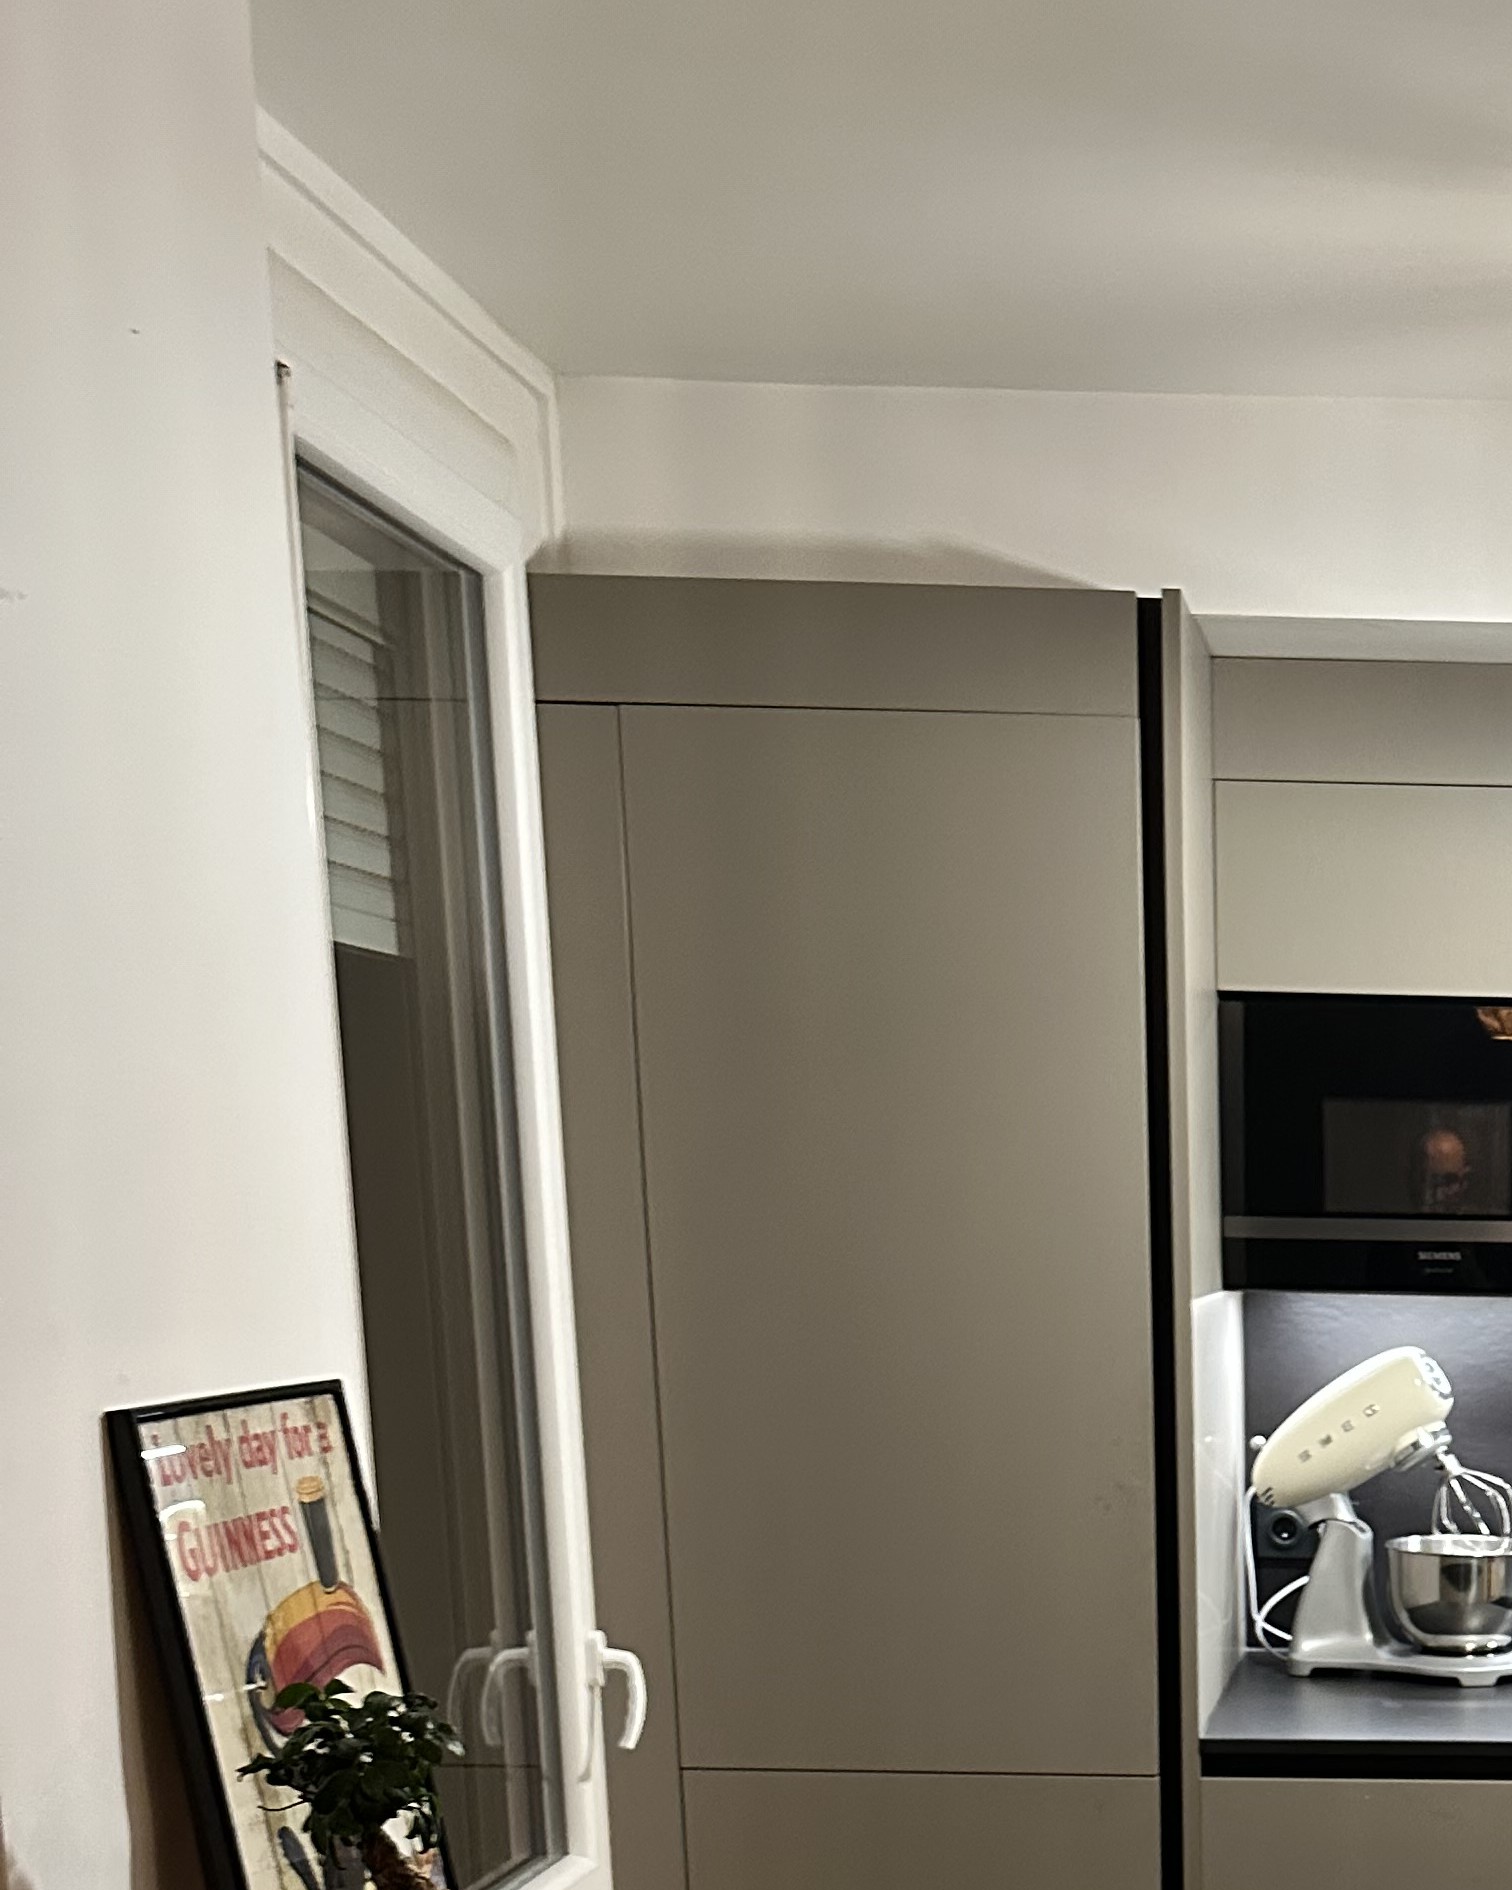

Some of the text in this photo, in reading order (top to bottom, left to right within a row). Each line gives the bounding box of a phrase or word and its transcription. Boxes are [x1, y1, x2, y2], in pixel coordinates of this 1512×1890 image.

[239, 1418, 279, 1475] day
[280, 1411, 314, 1461] for
[315, 1421, 334, 1455] a
[176, 1505, 300, 1582] GUINNESS
